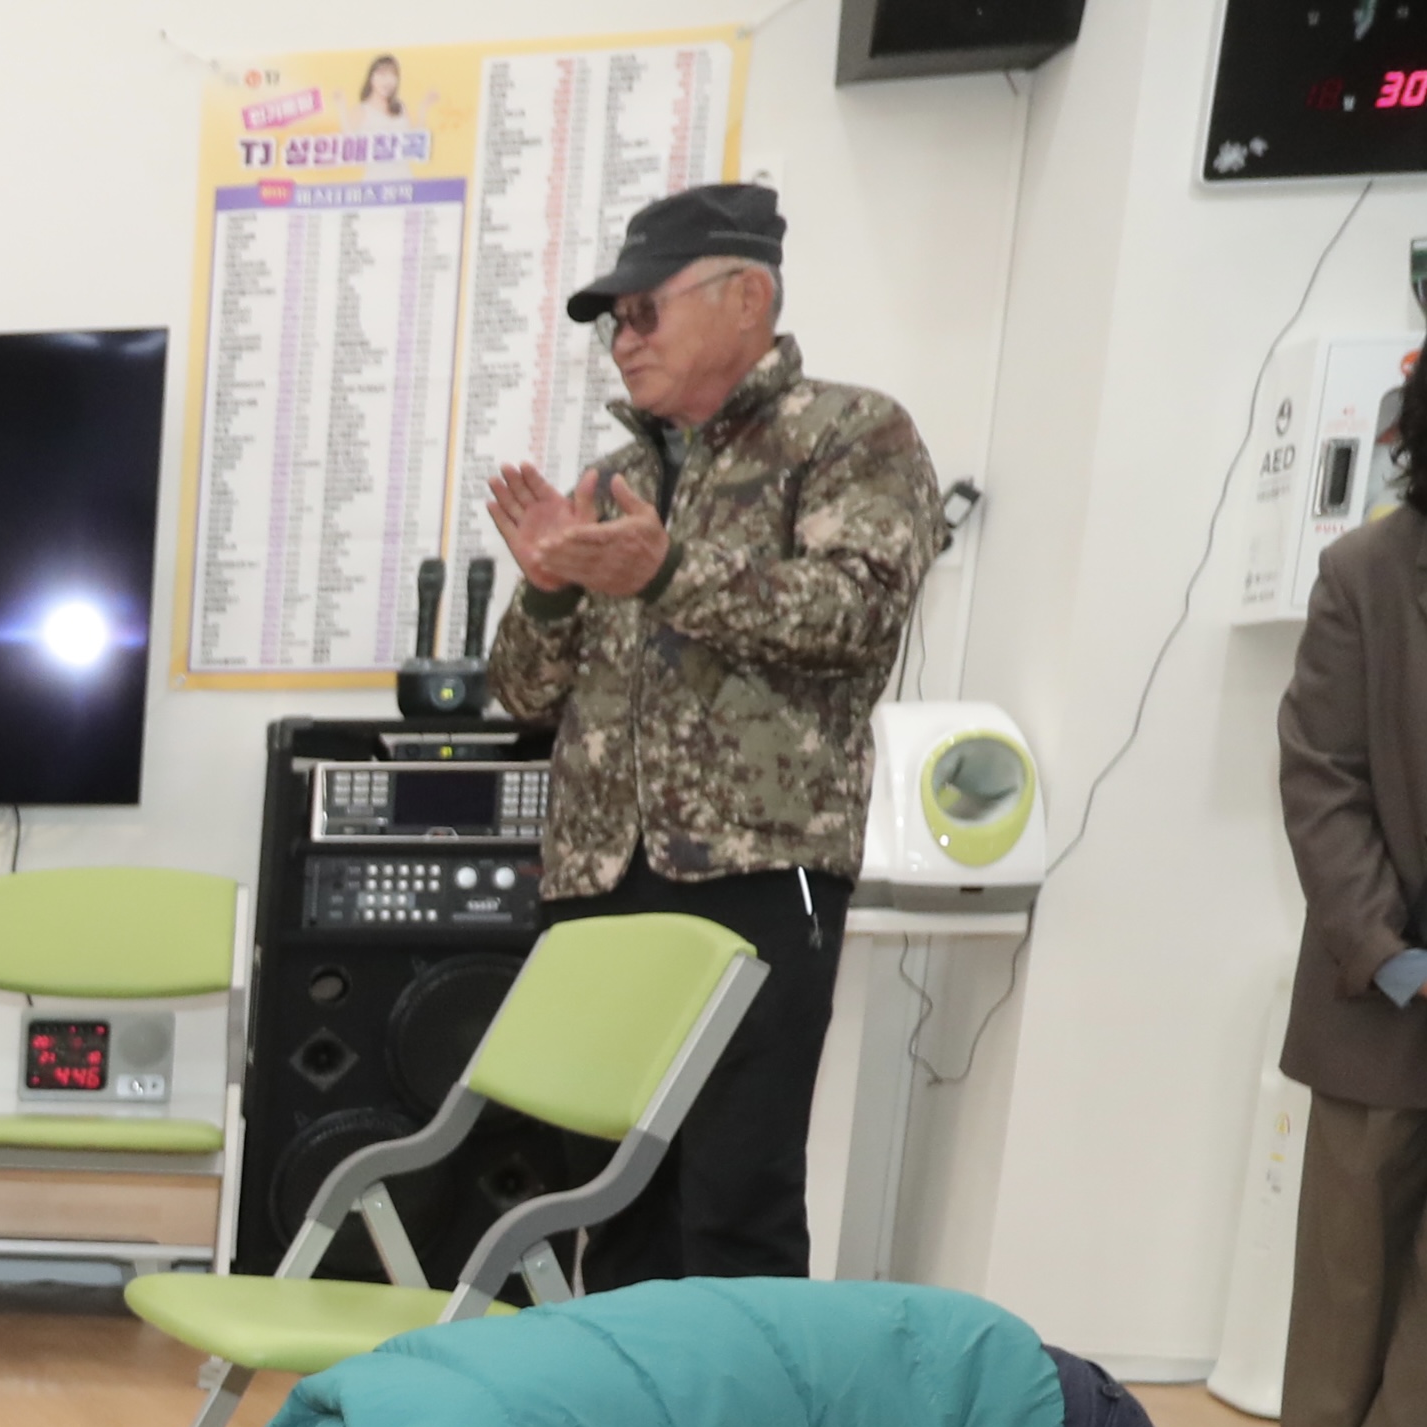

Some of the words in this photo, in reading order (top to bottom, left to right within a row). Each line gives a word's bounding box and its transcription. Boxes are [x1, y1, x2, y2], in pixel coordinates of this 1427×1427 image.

[1374, 69, 1427, 109] 30
[239, 139, 273, 167] TJ
[284, 132, 428, 166] 성인애창곡
[1259, 444, 1296, 478] AED
